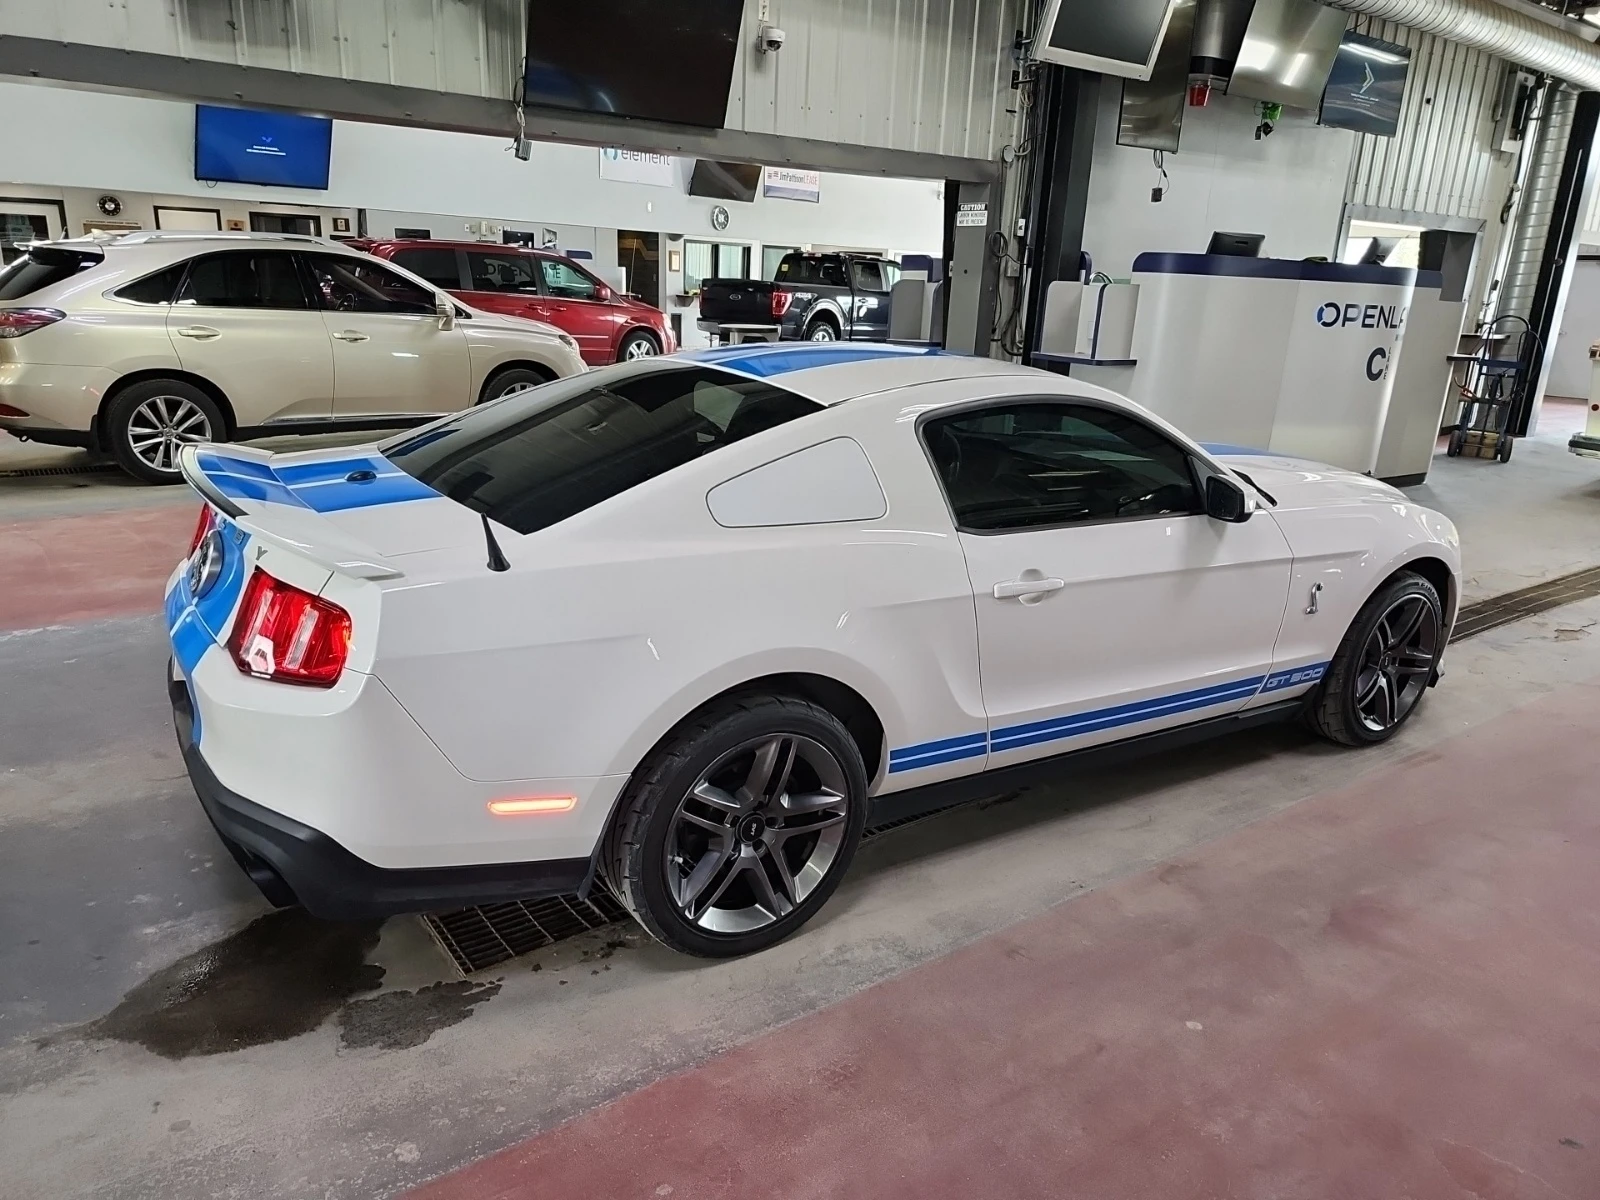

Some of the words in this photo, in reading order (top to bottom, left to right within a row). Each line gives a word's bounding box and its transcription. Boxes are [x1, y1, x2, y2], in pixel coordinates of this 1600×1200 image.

[621, 149, 670, 166] element
[960, 203, 986, 211] CAUTION
[1266, 675, 1291, 688] GT
[1289, 667, 1324, 683] 500
